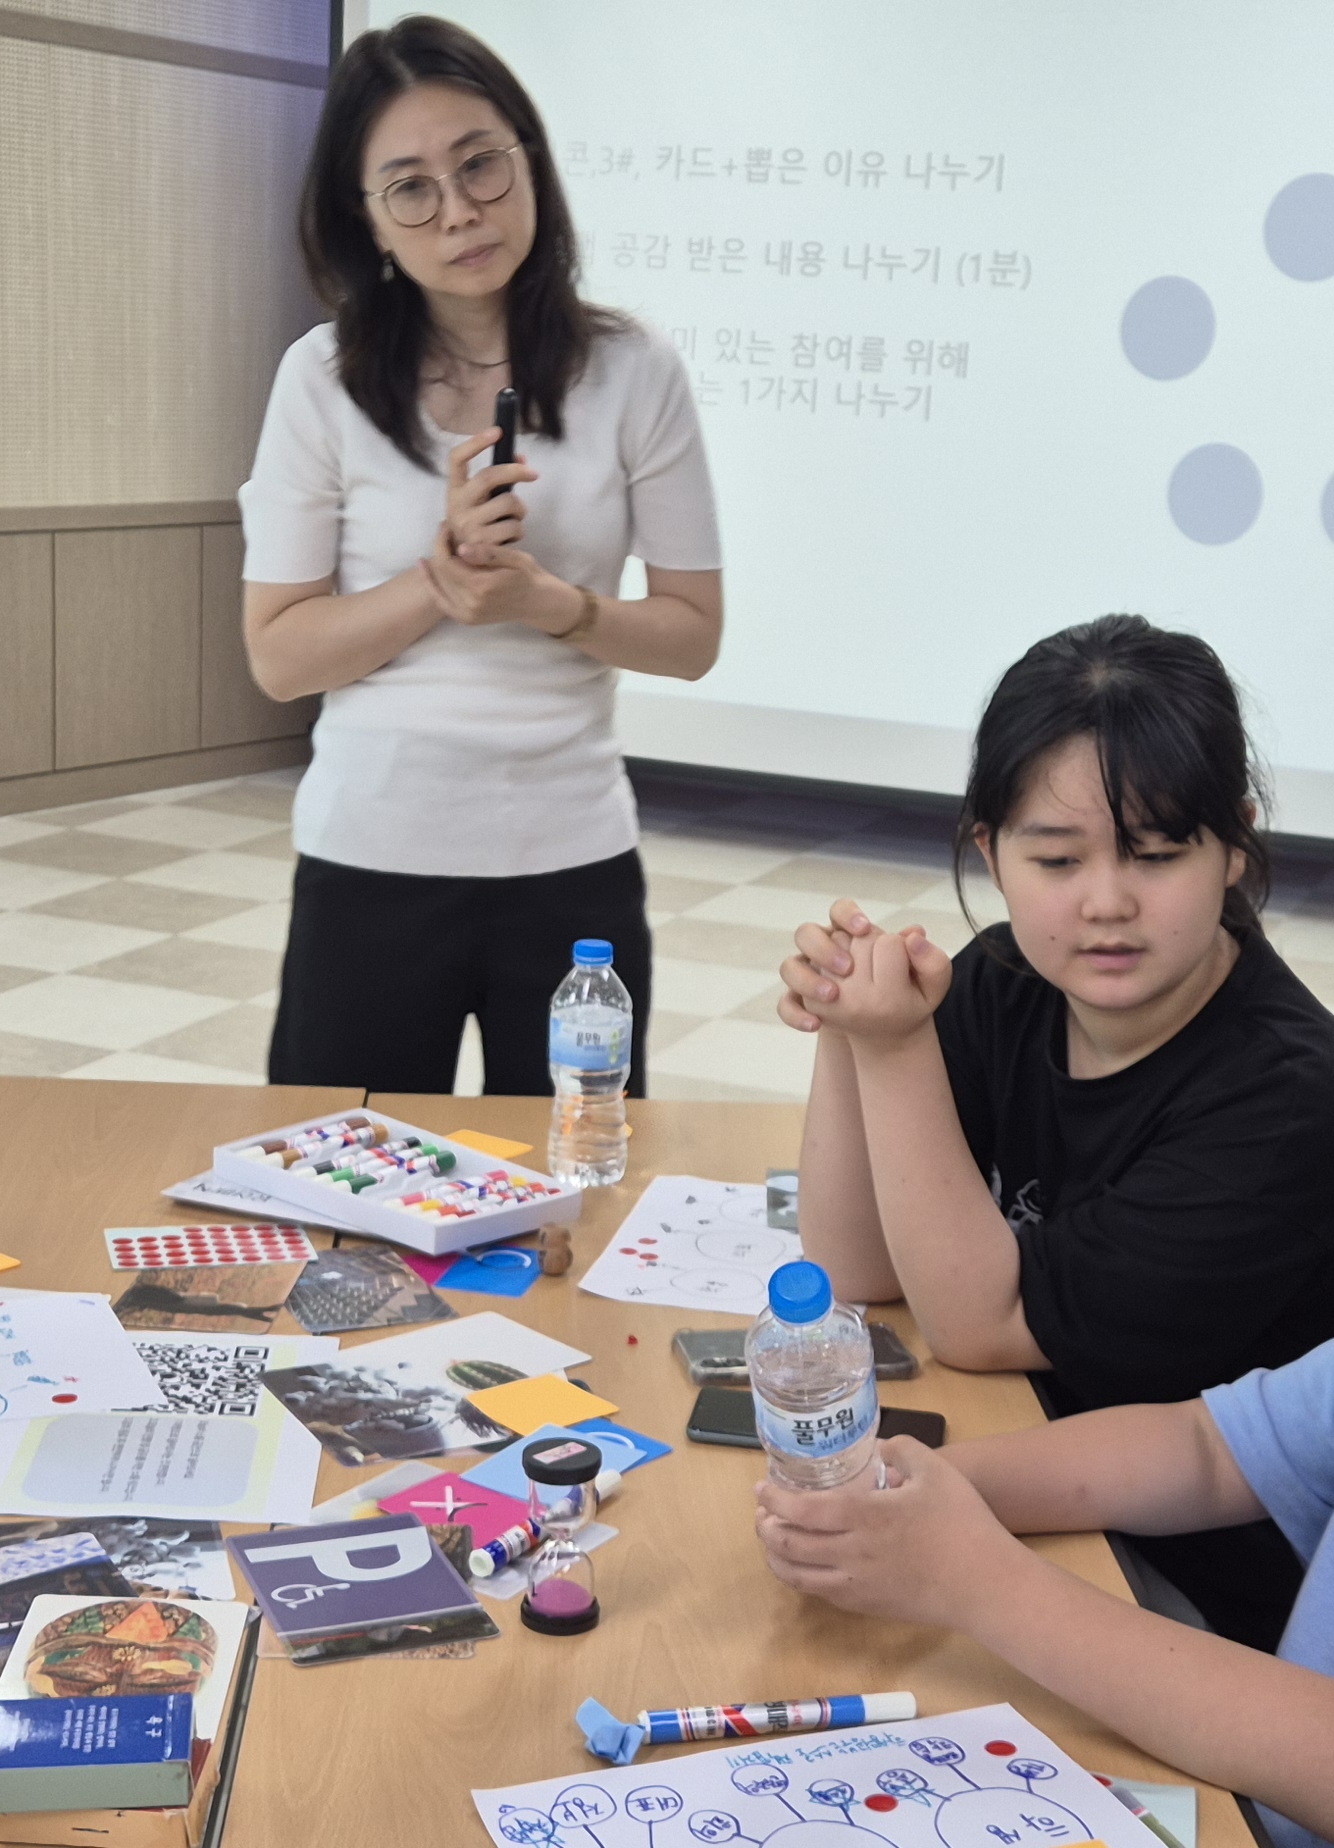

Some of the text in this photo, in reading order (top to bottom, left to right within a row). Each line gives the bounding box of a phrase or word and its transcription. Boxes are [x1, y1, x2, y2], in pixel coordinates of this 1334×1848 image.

[655, 144, 807, 186] 카드+뽑은
[824, 147, 888, 188] 이유
[904, 151, 1005, 192] 나누기
[611, 231, 671, 270] 공감
[688, 235, 748, 274] 받은
[764, 239, 826, 278] 내용
[843, 243, 941, 284] 나누기
[956, 249, 1032, 290] (1분)
[671, 326, 970, 378] 미 있는 참여를 위해
[692, 370, 932, 421] 는 1가지 나누기
[791, 1407, 855, 1446] 풀무원
